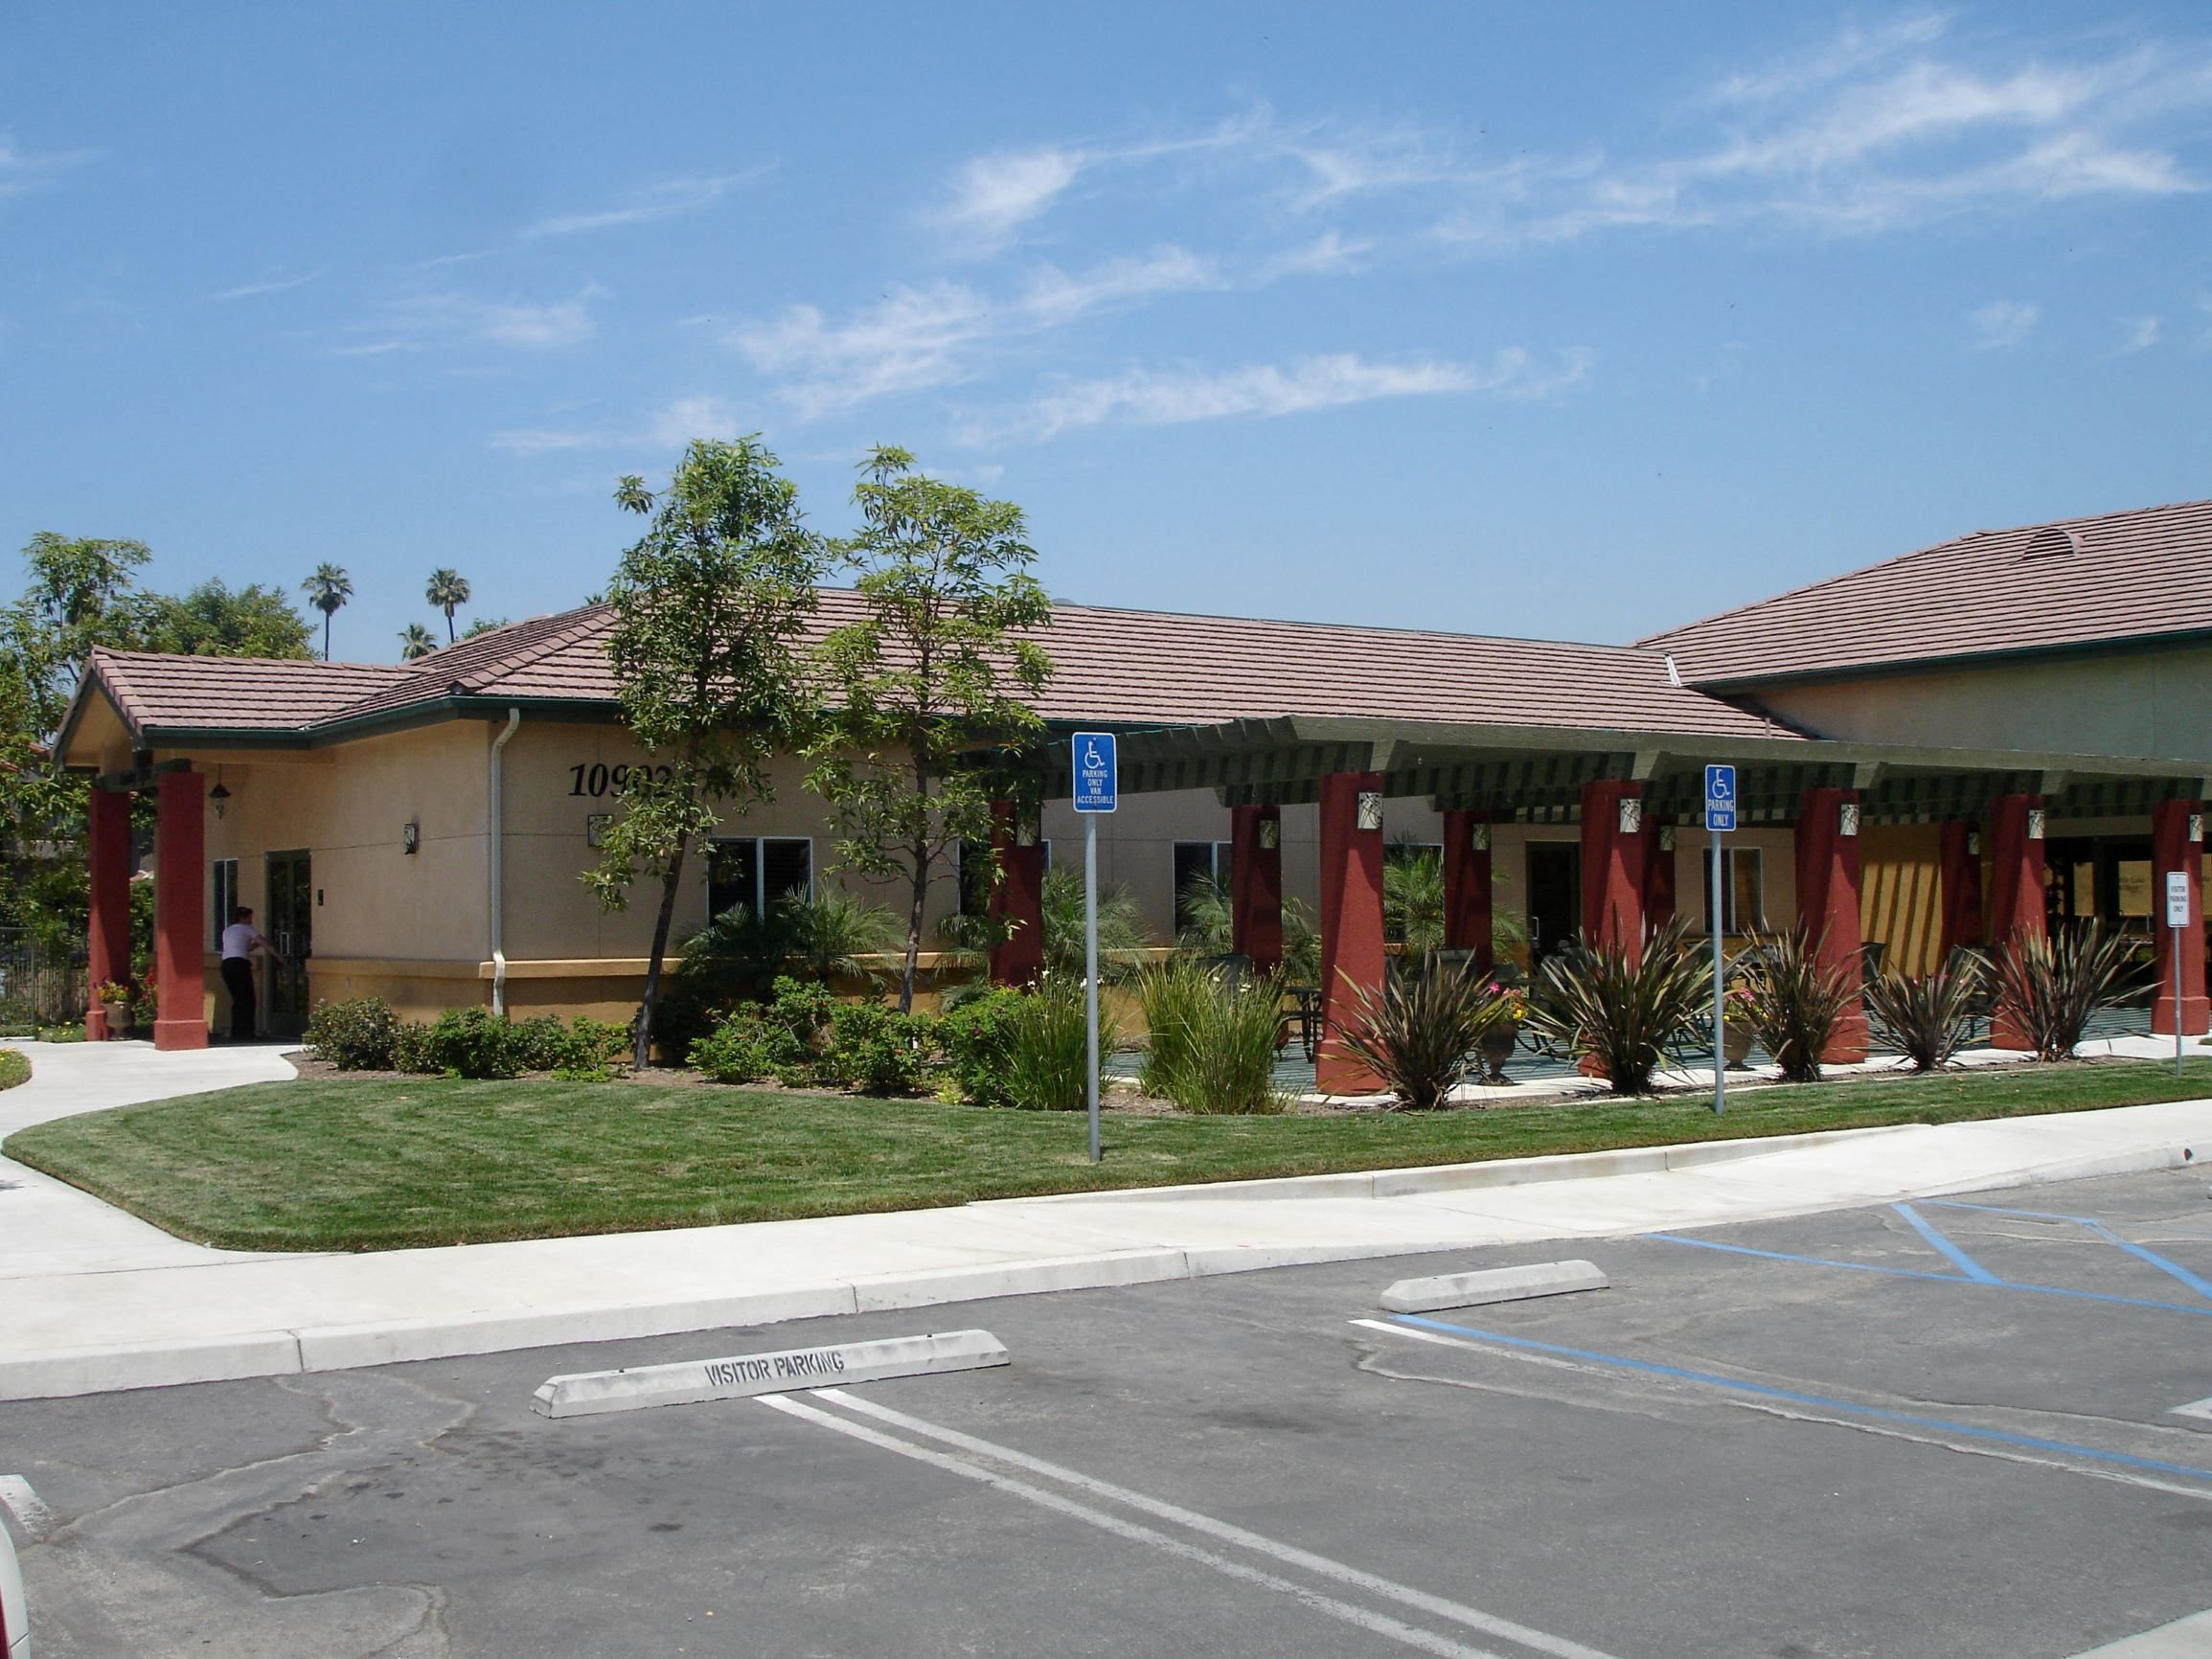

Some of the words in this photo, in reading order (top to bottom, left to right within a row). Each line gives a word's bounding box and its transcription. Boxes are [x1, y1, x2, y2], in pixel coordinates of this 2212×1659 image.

[1082, 769, 1108, 779] PARKING
[1089, 786, 1102, 795] VAN
[1077, 795, 1114, 805] ACCESSIBLE
[1708, 799, 1734, 812] PARKING
[1713, 813, 1729, 827] ONLY
[704, 1358, 772, 1386] VISITOR
[773, 1351, 845, 1377] PARKING
